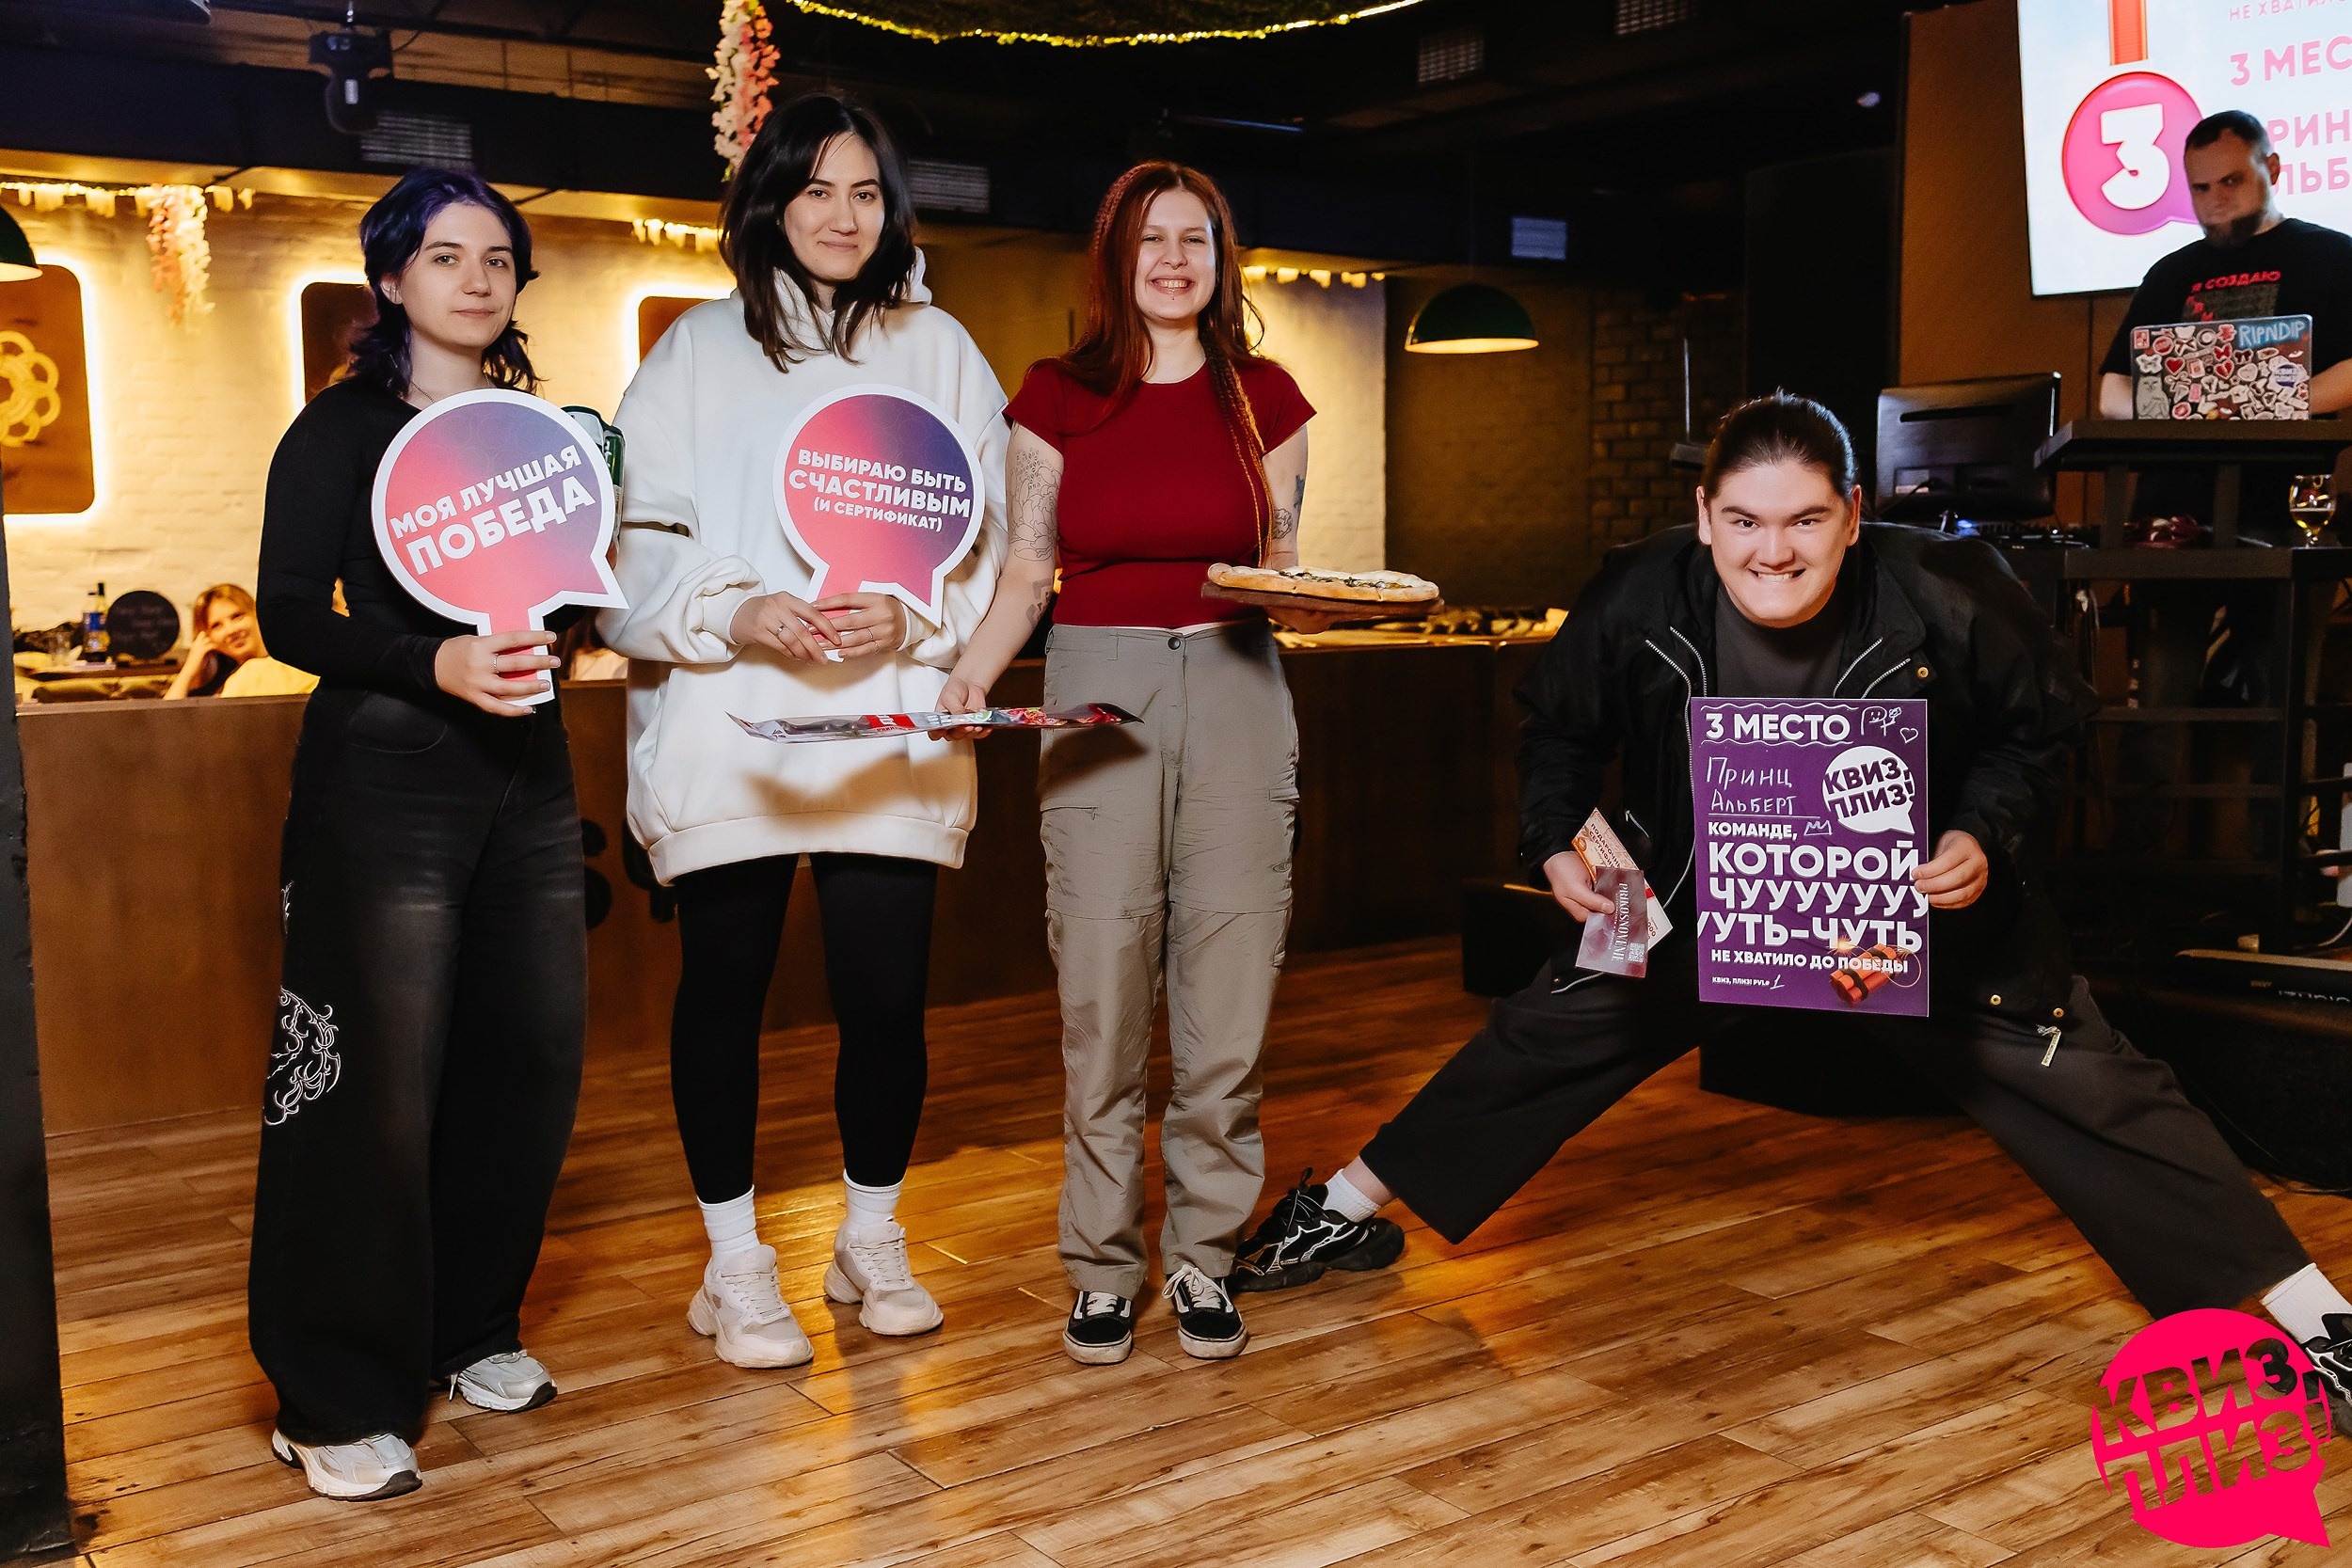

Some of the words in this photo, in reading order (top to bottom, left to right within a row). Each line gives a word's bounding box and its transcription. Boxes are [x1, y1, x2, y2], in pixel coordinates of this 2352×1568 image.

[2230, 5, 2250, 21] НЕ
[2230, 53, 2250, 86] 3
[2100, 103, 2170, 210] 3
[2239, 321, 2305, 347] RIPNDIP
[798, 449, 907, 482] ВЫБИРАЮ
[911, 468, 967, 493] БЫТЬ
[389, 495, 458, 539] МОЯ
[459, 444, 582, 512] ЛУЧШАЯ
[788, 469, 971, 518] СЧАСТЛИВЫМ
[405, 475, 596, 576] ПОБЕДА
[814, 497, 830, 512] (И
[834, 501, 943, 532] СЕРТИФИКАТ)
[1706, 713, 1724, 739] 3
[1735, 714, 1851, 741] МЕСТО
[1708, 821, 1798, 840] КОМАНДЕ,
[1708, 840, 1919, 880] КОТОРОЙ
[1612, 883, 1629, 961] PRIKOSNOVENIE
[1711, 949, 1730, 962] НЕ
[1733, 950, 1806, 967] ХВАТИЛО
[1809, 956, 1835, 970] ДО
[1837, 957, 1908, 973] ПОБЕДЫ
